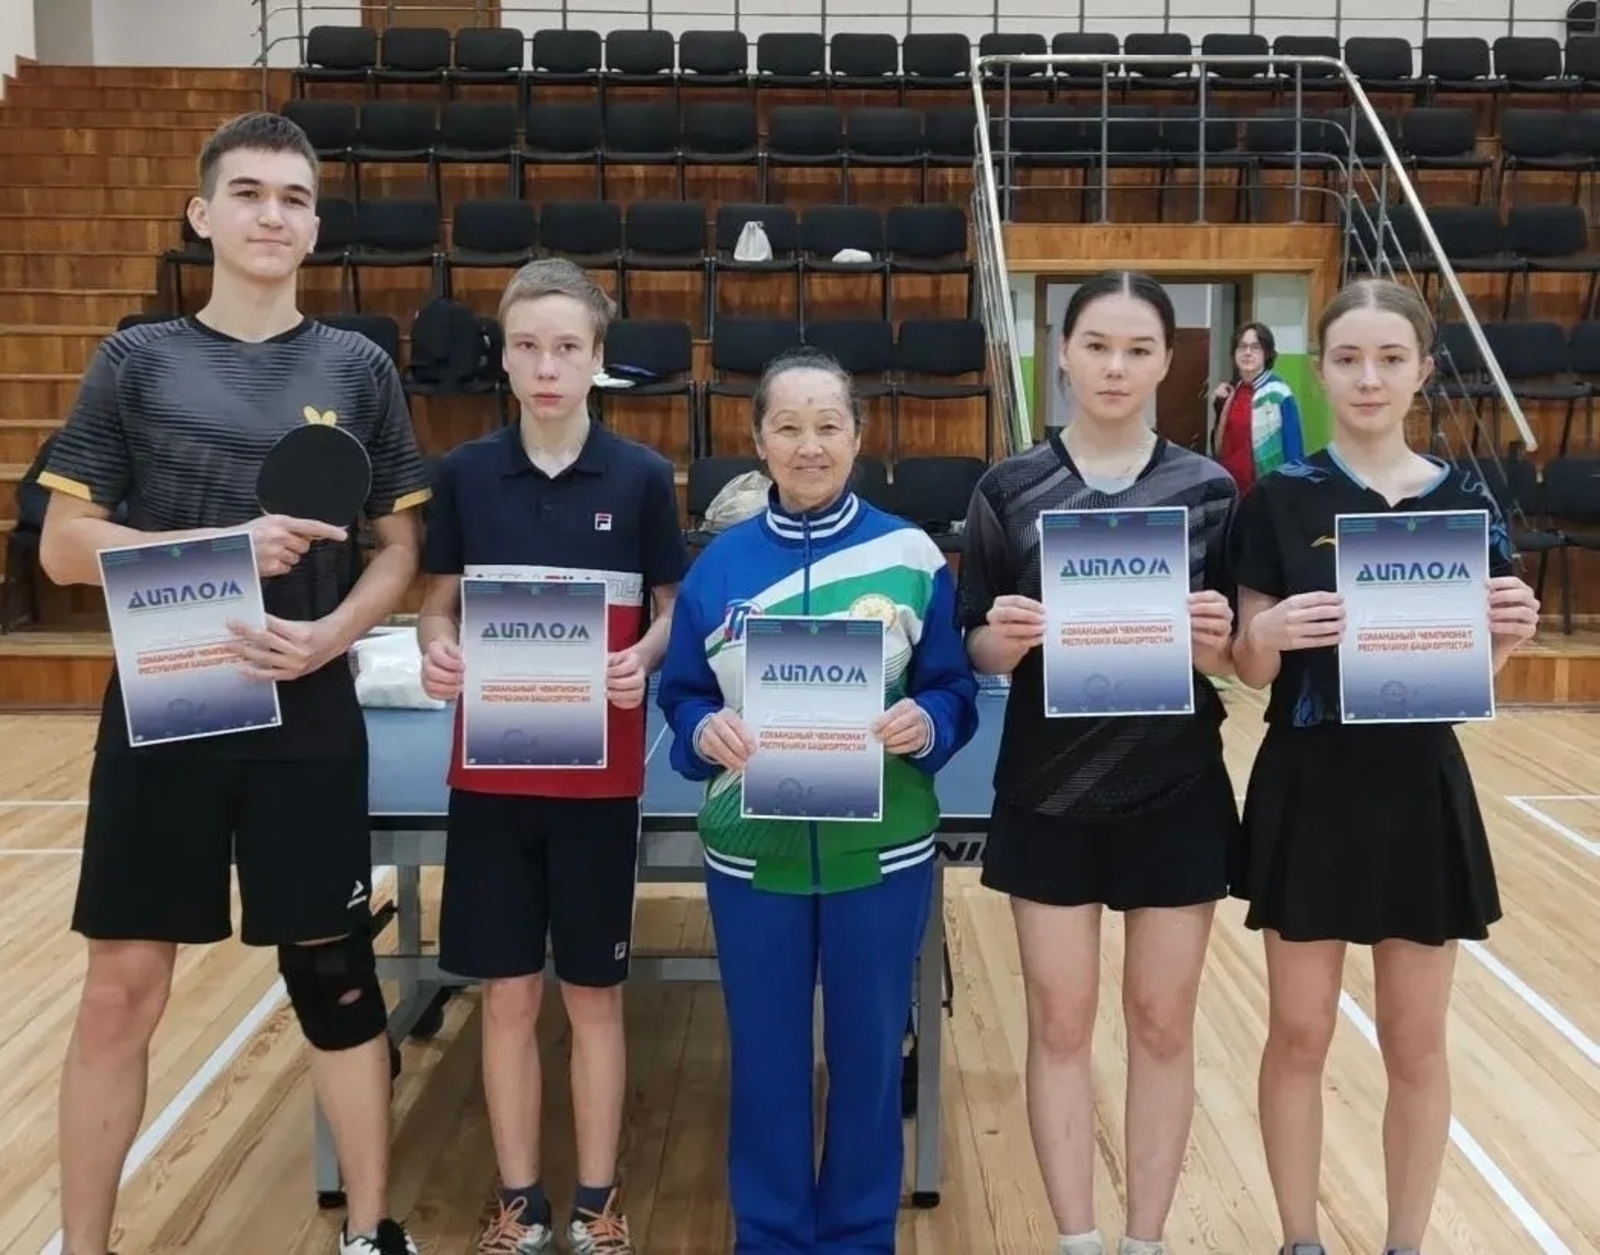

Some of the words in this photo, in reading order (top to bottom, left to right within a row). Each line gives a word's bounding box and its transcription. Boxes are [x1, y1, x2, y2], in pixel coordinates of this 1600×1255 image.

[1060, 557, 1171, 577] ДИПЛОМ
[1356, 562, 1470, 581] ДИПЛОМ
[127, 579, 243, 609] ДИПЛОМ
[481, 622, 590, 639] ДИПЛОМ
[1061, 627, 1118, 636] КОМАНДНЫЙ
[1120, 625, 1173, 634] ЧЕМПИОНАТ
[1357, 632, 1416, 641] КОМАНДНЫЙ
[1418, 630, 1473, 639] ЧЕМПИОНАТ
[1061, 637, 1111, 646] РЕСПУБЛИКИ
[1113, 635, 1173, 645] БАШКОРТОСТАН
[1358, 643, 1409, 652] РЕСПУБЛИКИ
[1410, 641, 1474, 651] БАШКОРТОСТАН
[761, 664, 867, 683] ДИПЛОМ
[539, 685, 590, 694] ЧЕМПИОНАТ
[760, 730, 814, 740] КОМАНДНЫЙ
[815, 732, 866, 741] ЧЕМПИОНАТ
[760, 741, 806, 750] РЕСПУБЛИКИ
[807, 742, 867, 752] БАШКОРТОСТАН
